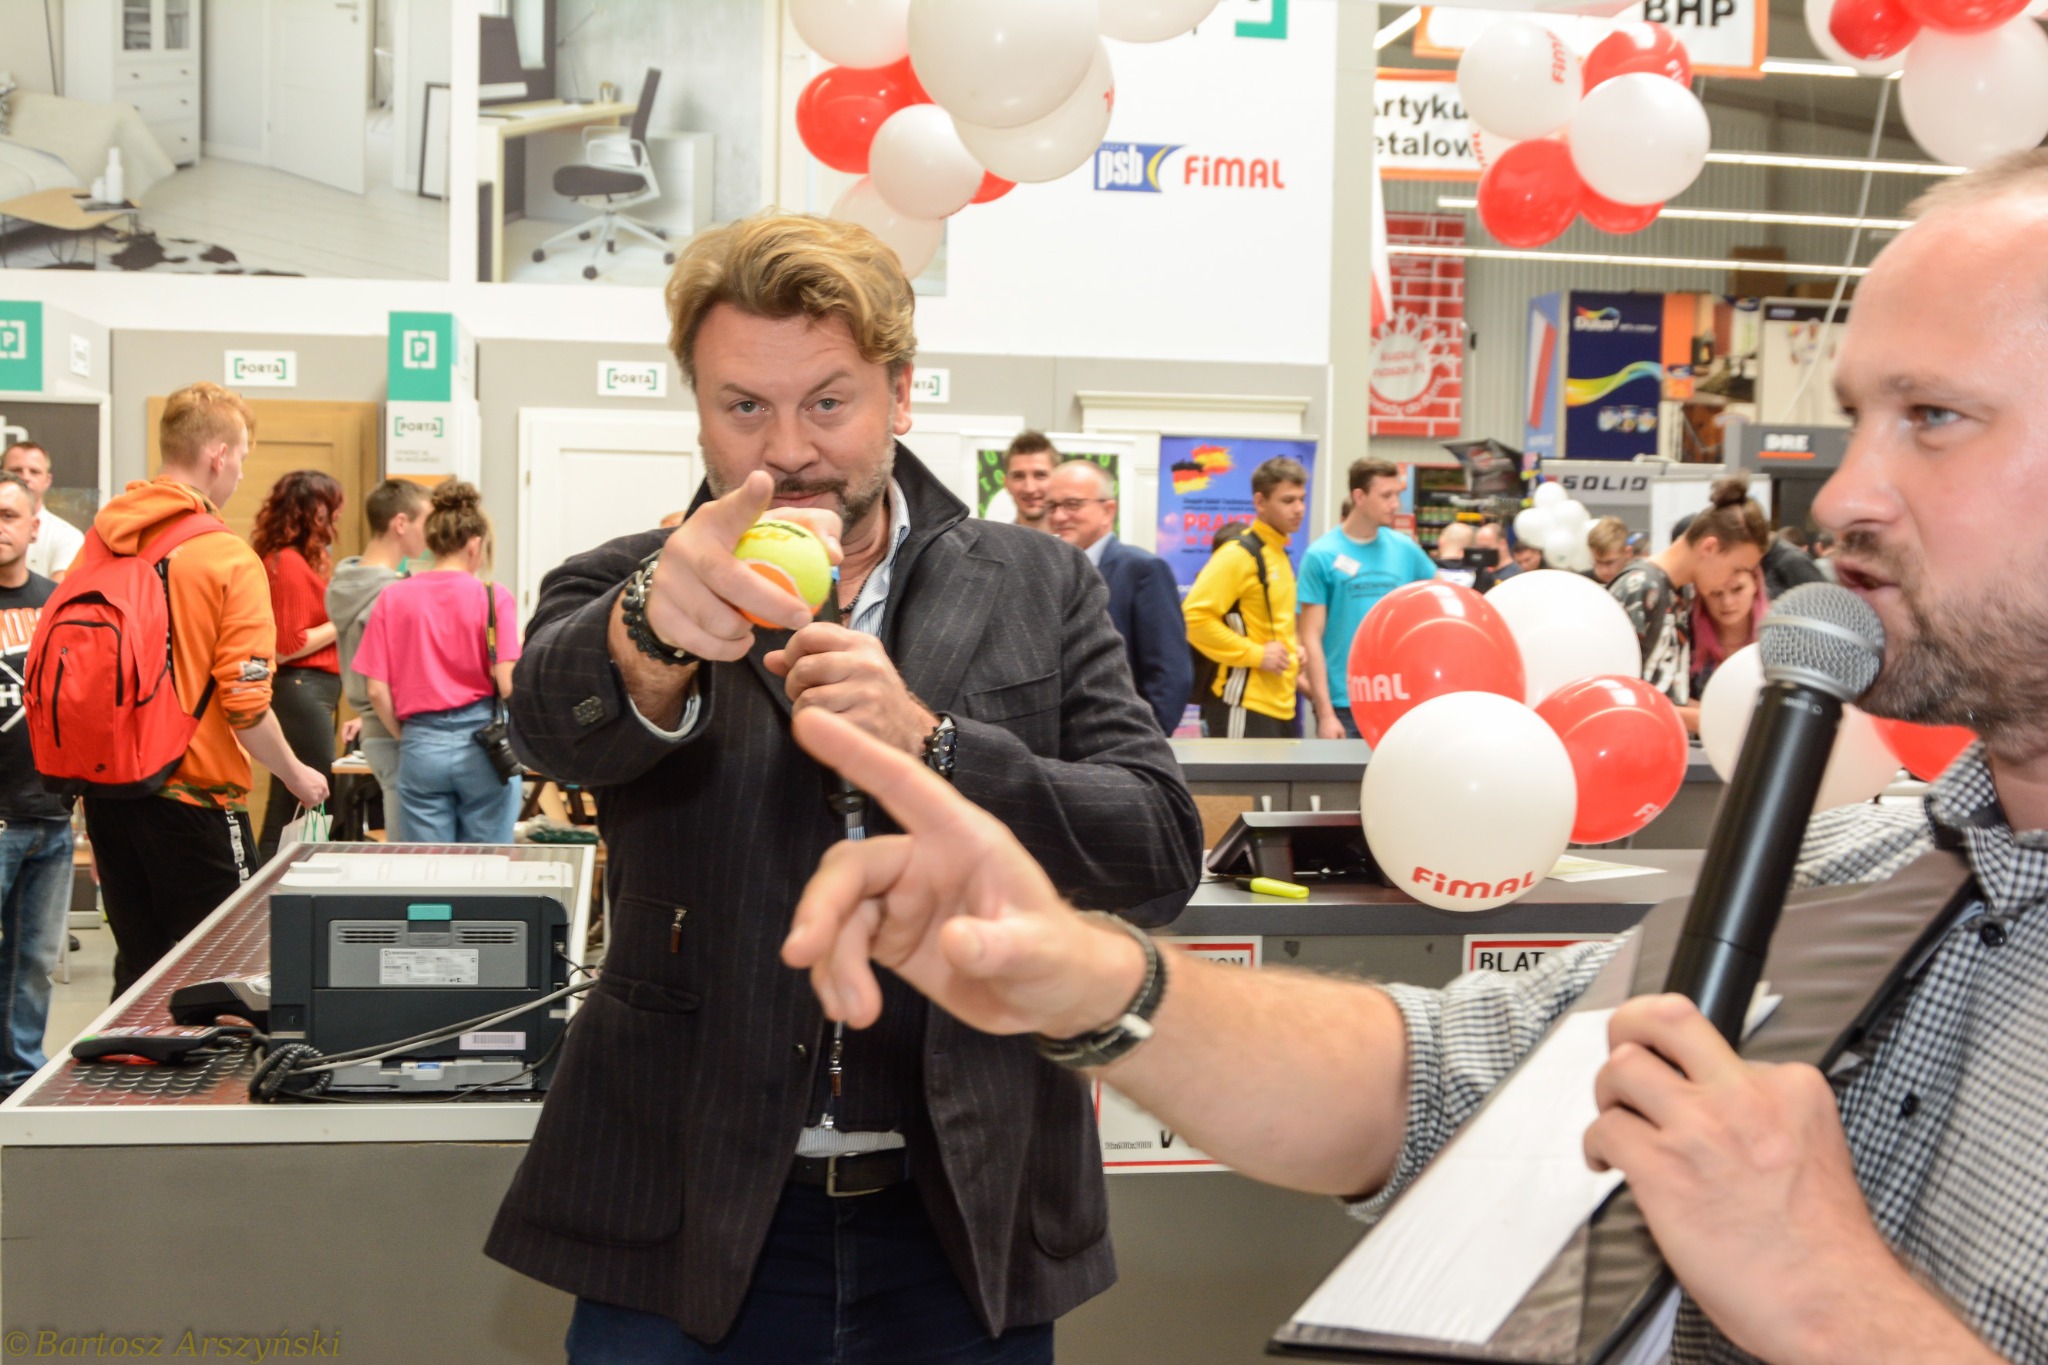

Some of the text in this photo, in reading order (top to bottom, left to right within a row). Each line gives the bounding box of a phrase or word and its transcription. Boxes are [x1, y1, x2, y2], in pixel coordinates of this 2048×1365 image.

[1643, 0, 1736, 28] BHP
[1374, 94, 1469, 125] rtyku
[1375, 131, 1473, 157] etalow
[1099, 144, 1144, 189] psb
[240, 363, 281, 374] PORTA
[612, 374, 652, 385] PORTA
[400, 422, 438, 432] PORTA
[1764, 433, 1810, 452] DRE
[1183, 512, 1257, 532] PRAKT
